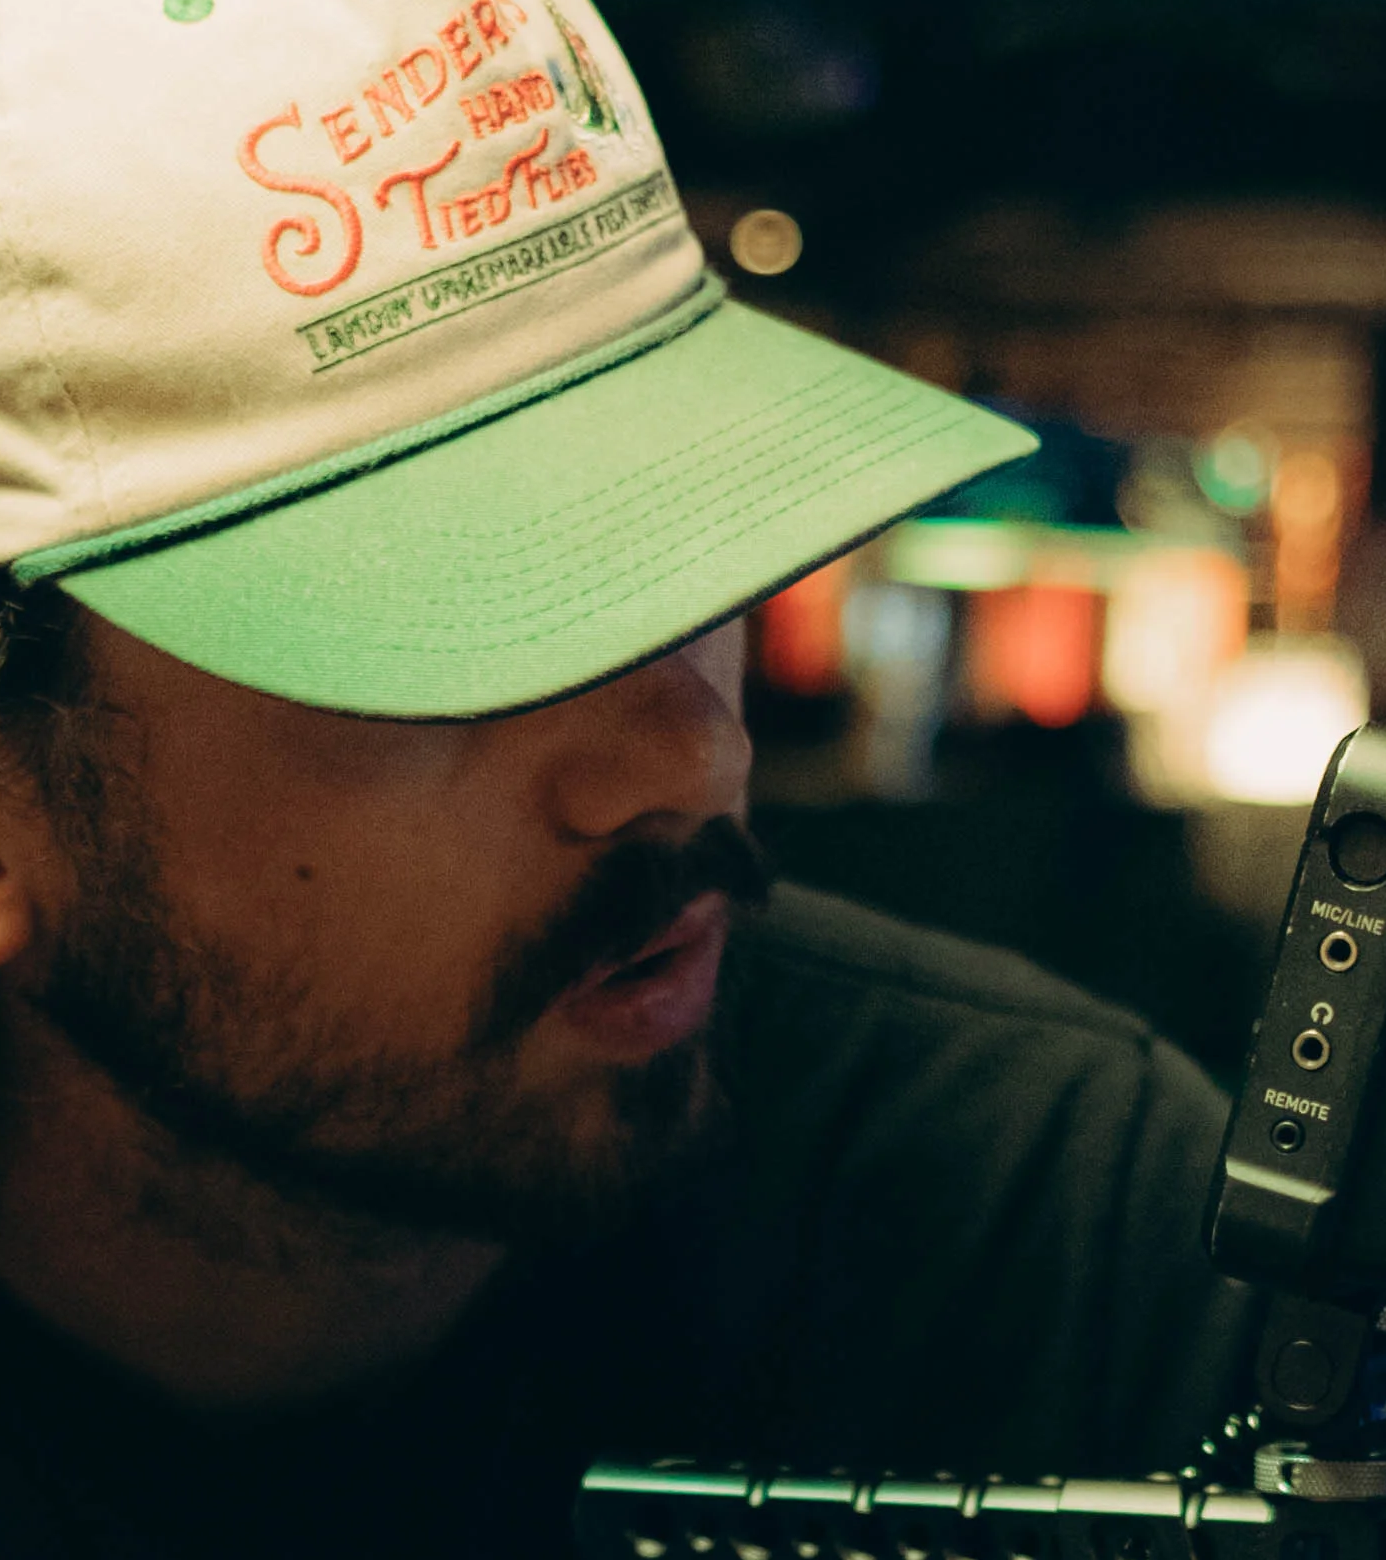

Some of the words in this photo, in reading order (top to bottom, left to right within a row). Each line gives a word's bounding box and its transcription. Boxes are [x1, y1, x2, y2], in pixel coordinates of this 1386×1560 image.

[459, 68, 555, 139] HAND
[374, 140, 512, 249] TIED
[504, 127, 597, 209] FLIES
[1310, 899, 1386, 936] MIC/LINE
[1263, 1087, 1331, 1122] REMOTE
